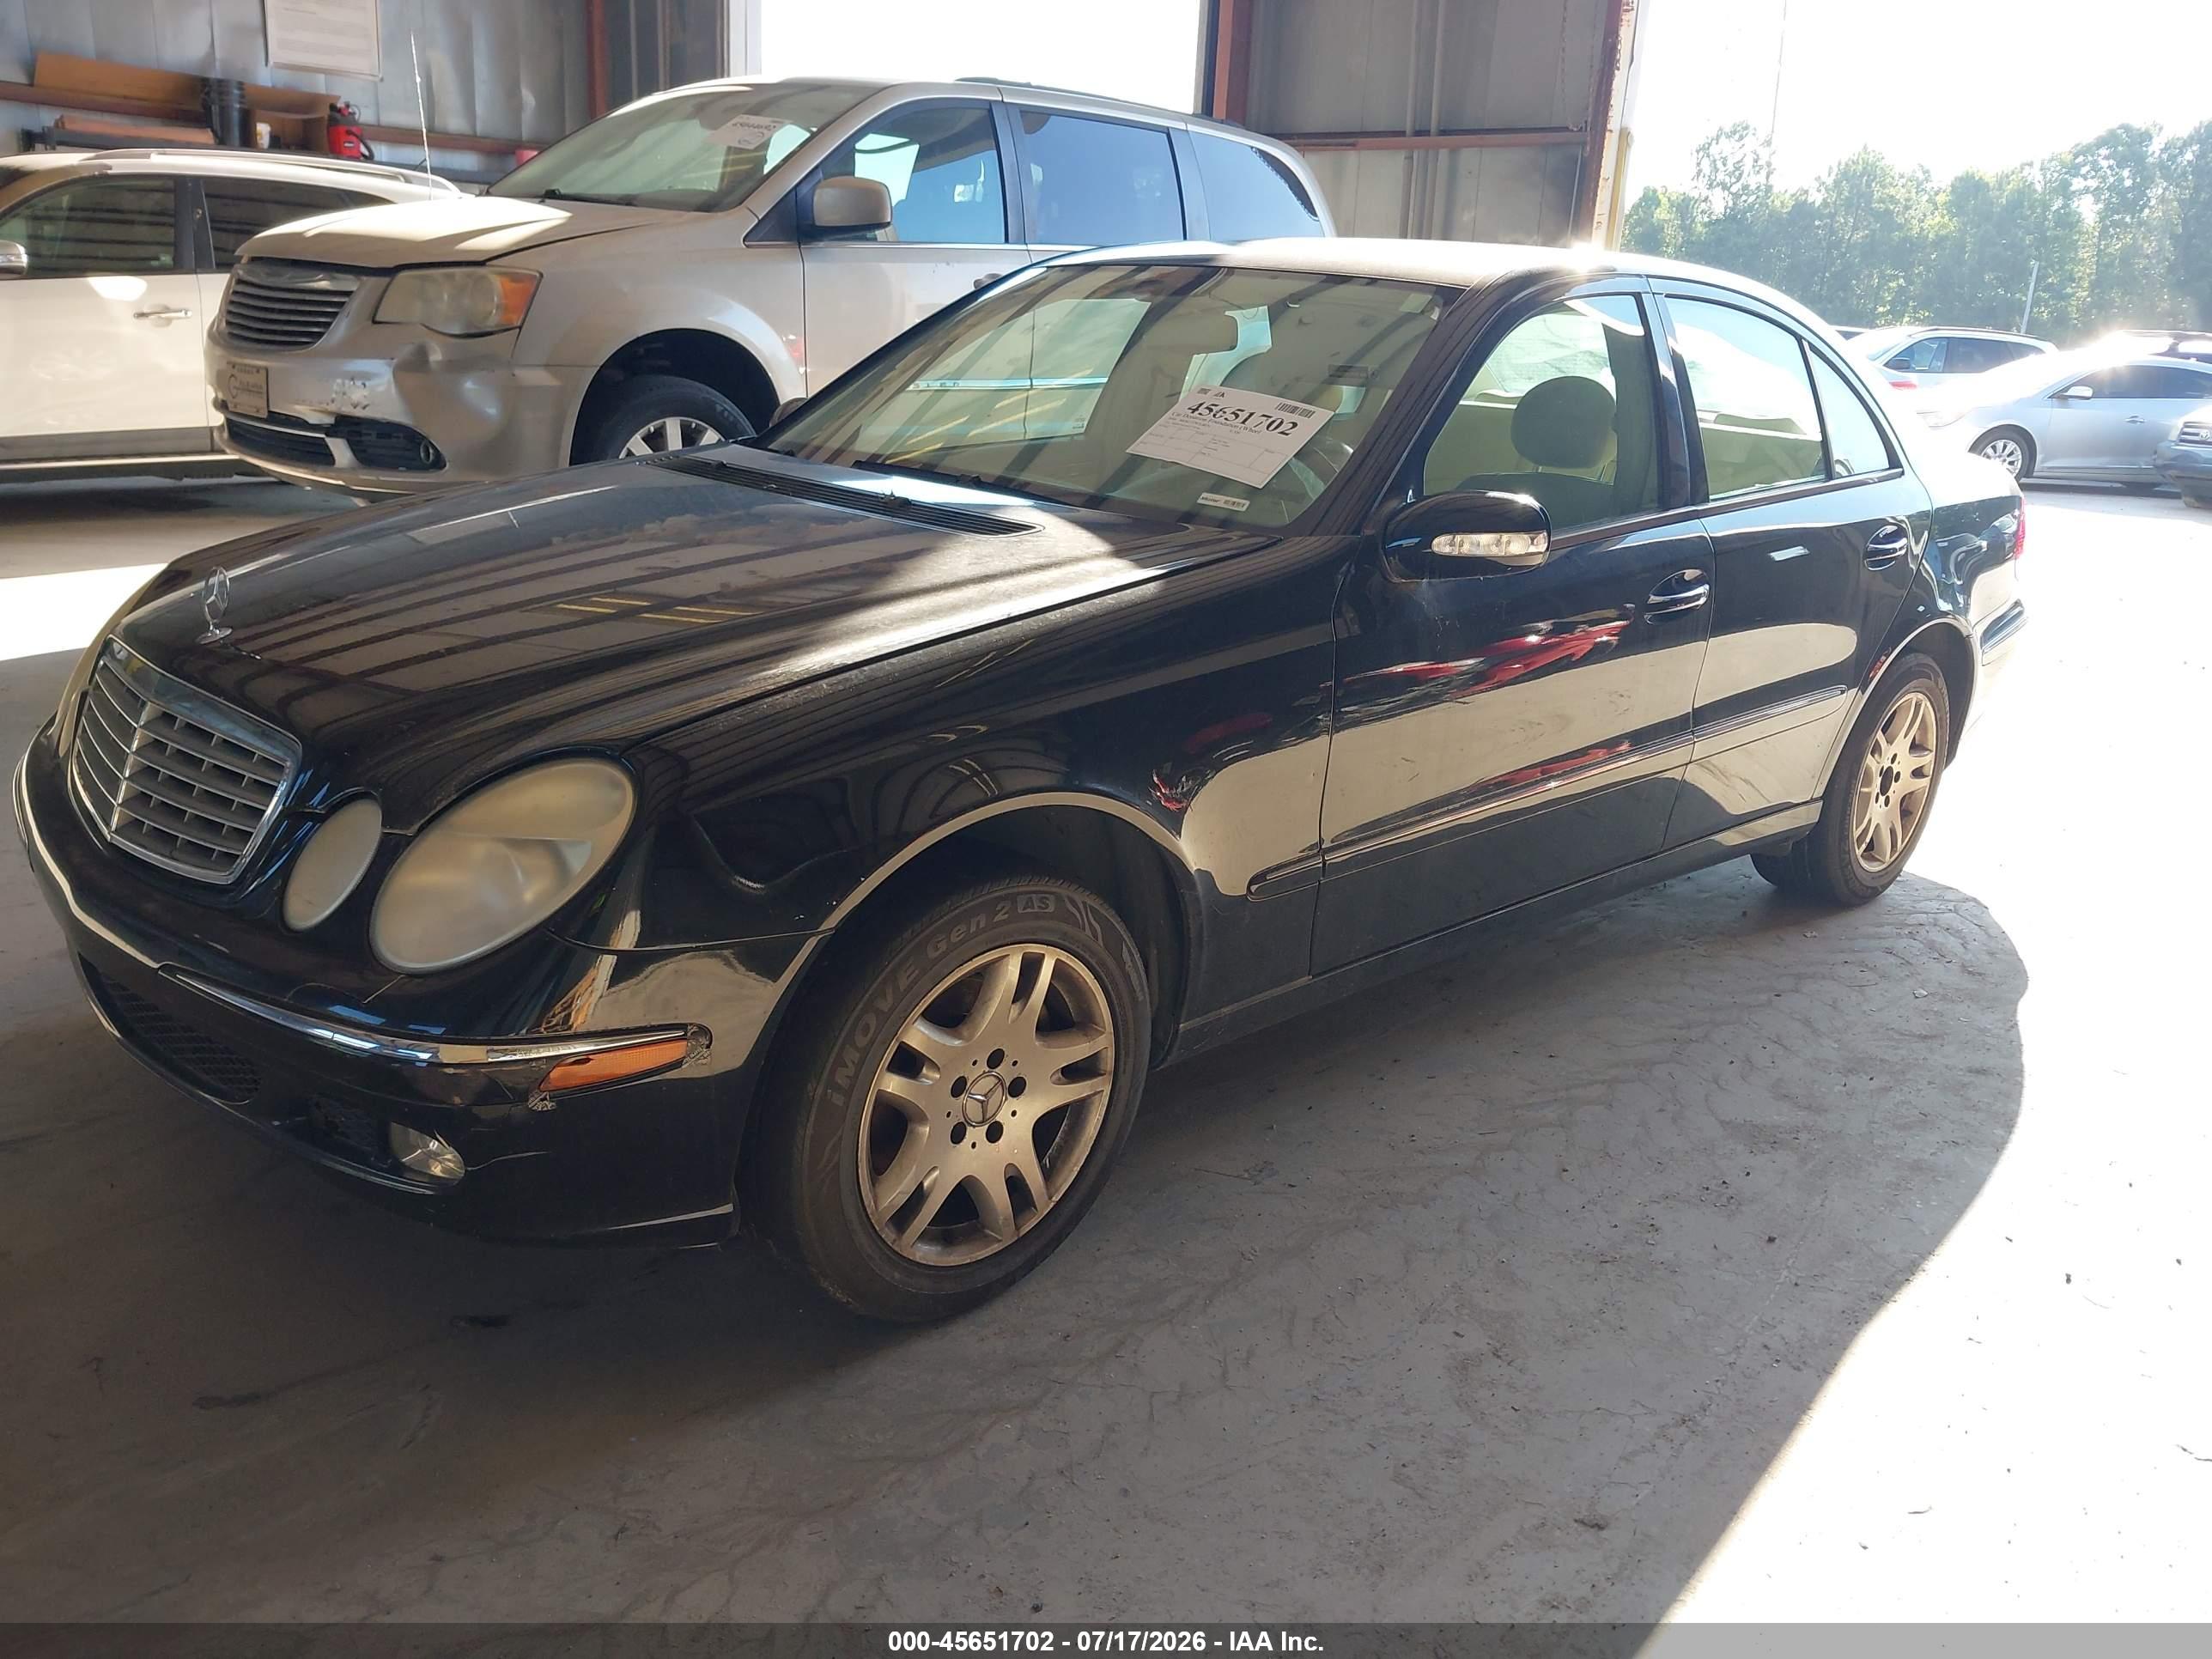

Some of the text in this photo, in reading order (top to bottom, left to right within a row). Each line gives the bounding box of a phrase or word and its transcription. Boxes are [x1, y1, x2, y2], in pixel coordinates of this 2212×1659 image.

[1187, 401, 1298, 436] 45651702
[927, 913, 987, 959] Gen
[992, 900, 1012, 922] 2
